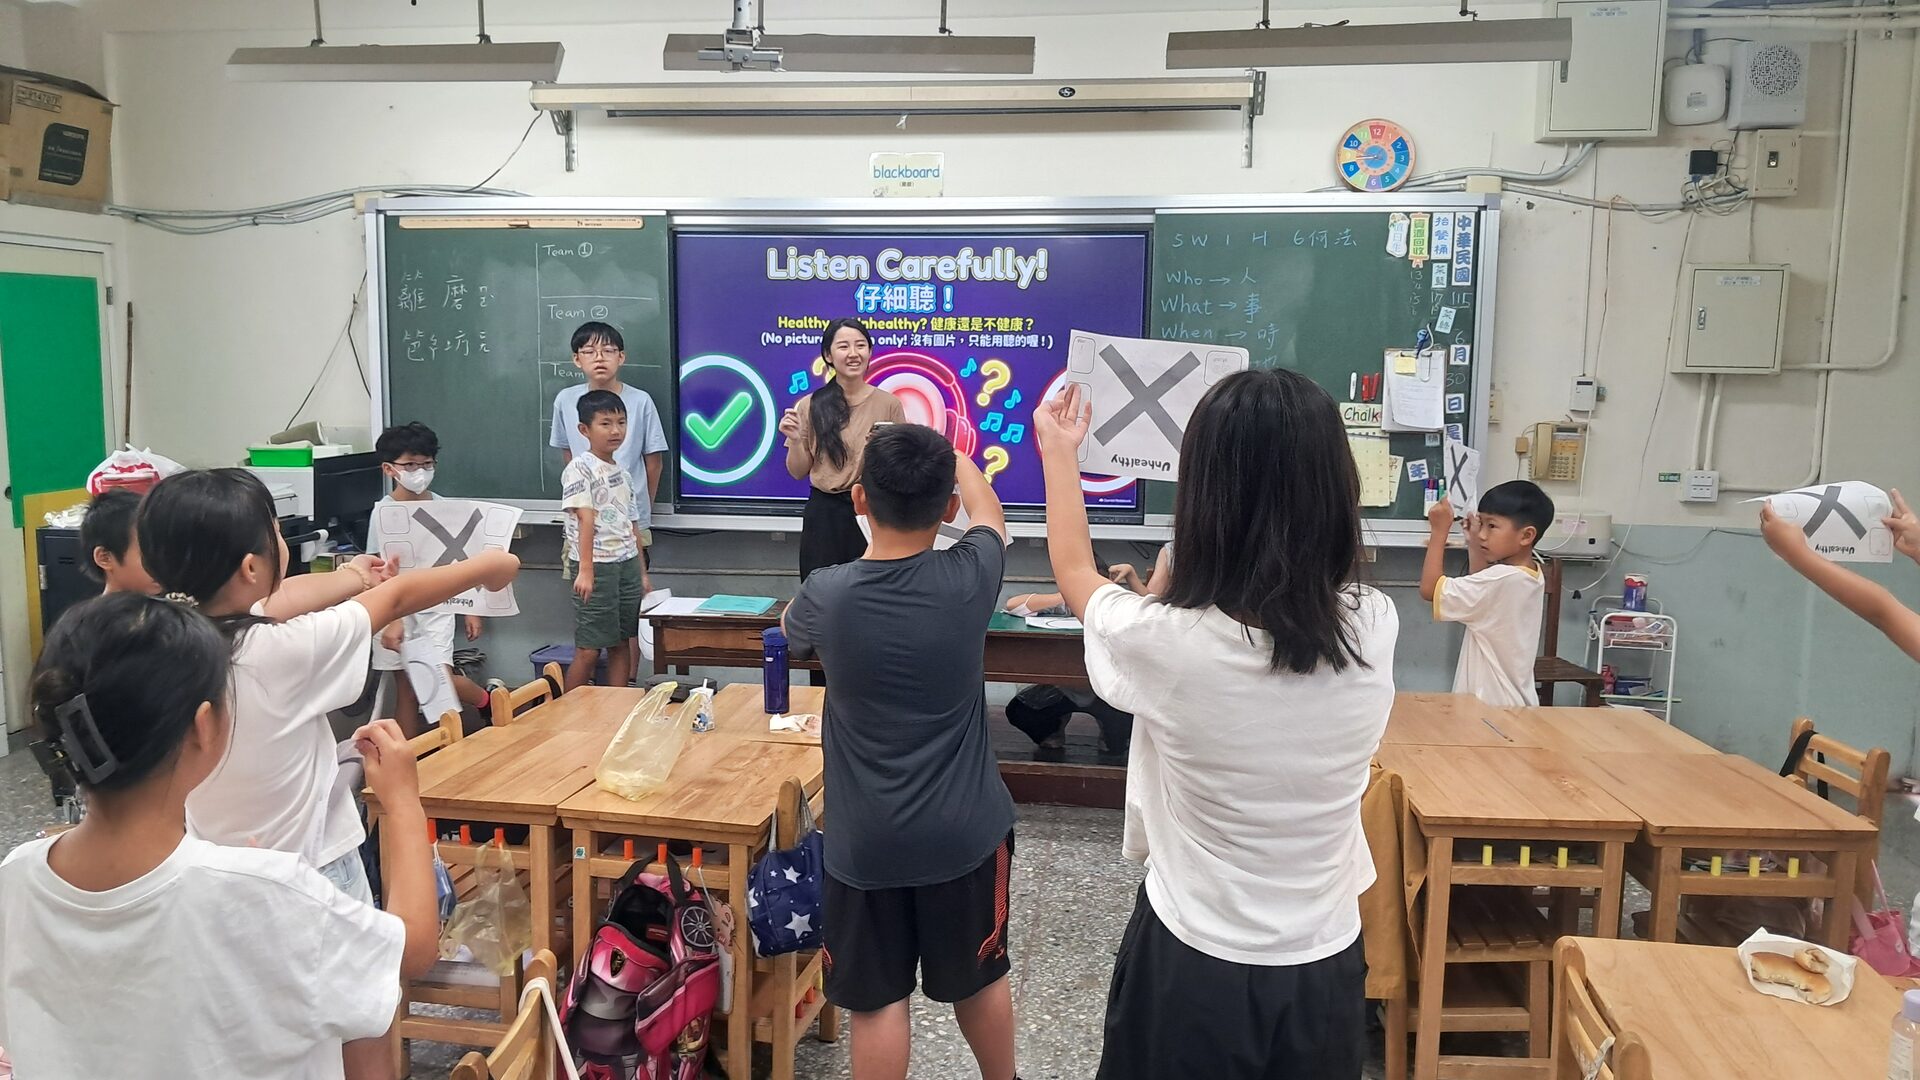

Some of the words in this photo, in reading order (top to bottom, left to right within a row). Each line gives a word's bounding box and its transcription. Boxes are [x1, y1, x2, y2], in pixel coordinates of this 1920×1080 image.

[873, 165, 940, 178] blackboard
[1385, 175, 1390, 183] 5
[542, 244, 574, 256] Team
[1455, 214, 1472, 283] 中華民國
[767, 247, 870, 280] Listen
[876, 247, 1048, 289] Carefully!
[1166, 271, 1203, 286] Who
[1240, 267, 1256, 284] 人
[855, 283, 954, 313] 仔細聽！
[1161, 294, 1213, 315] What
[547, 304, 585, 319] Team
[777, 316, 830, 331] Healthy
[857, 316, 928, 332] nhealthy?
[930, 316, 1035, 331] 健康還是不健康？
[1161, 322, 1213, 339] When
[761, 332, 782, 346] (No
[878, 333, 908, 348] only!
[1454, 346, 1467, 362] 月
[550, 362, 585, 379] Team
[1448, 396, 1462, 411] 日
[1344, 406, 1379, 421] Chalk
[1111, 453, 1171, 472] Unhealthy
[1815, 543, 1855, 555] Unhealthy
